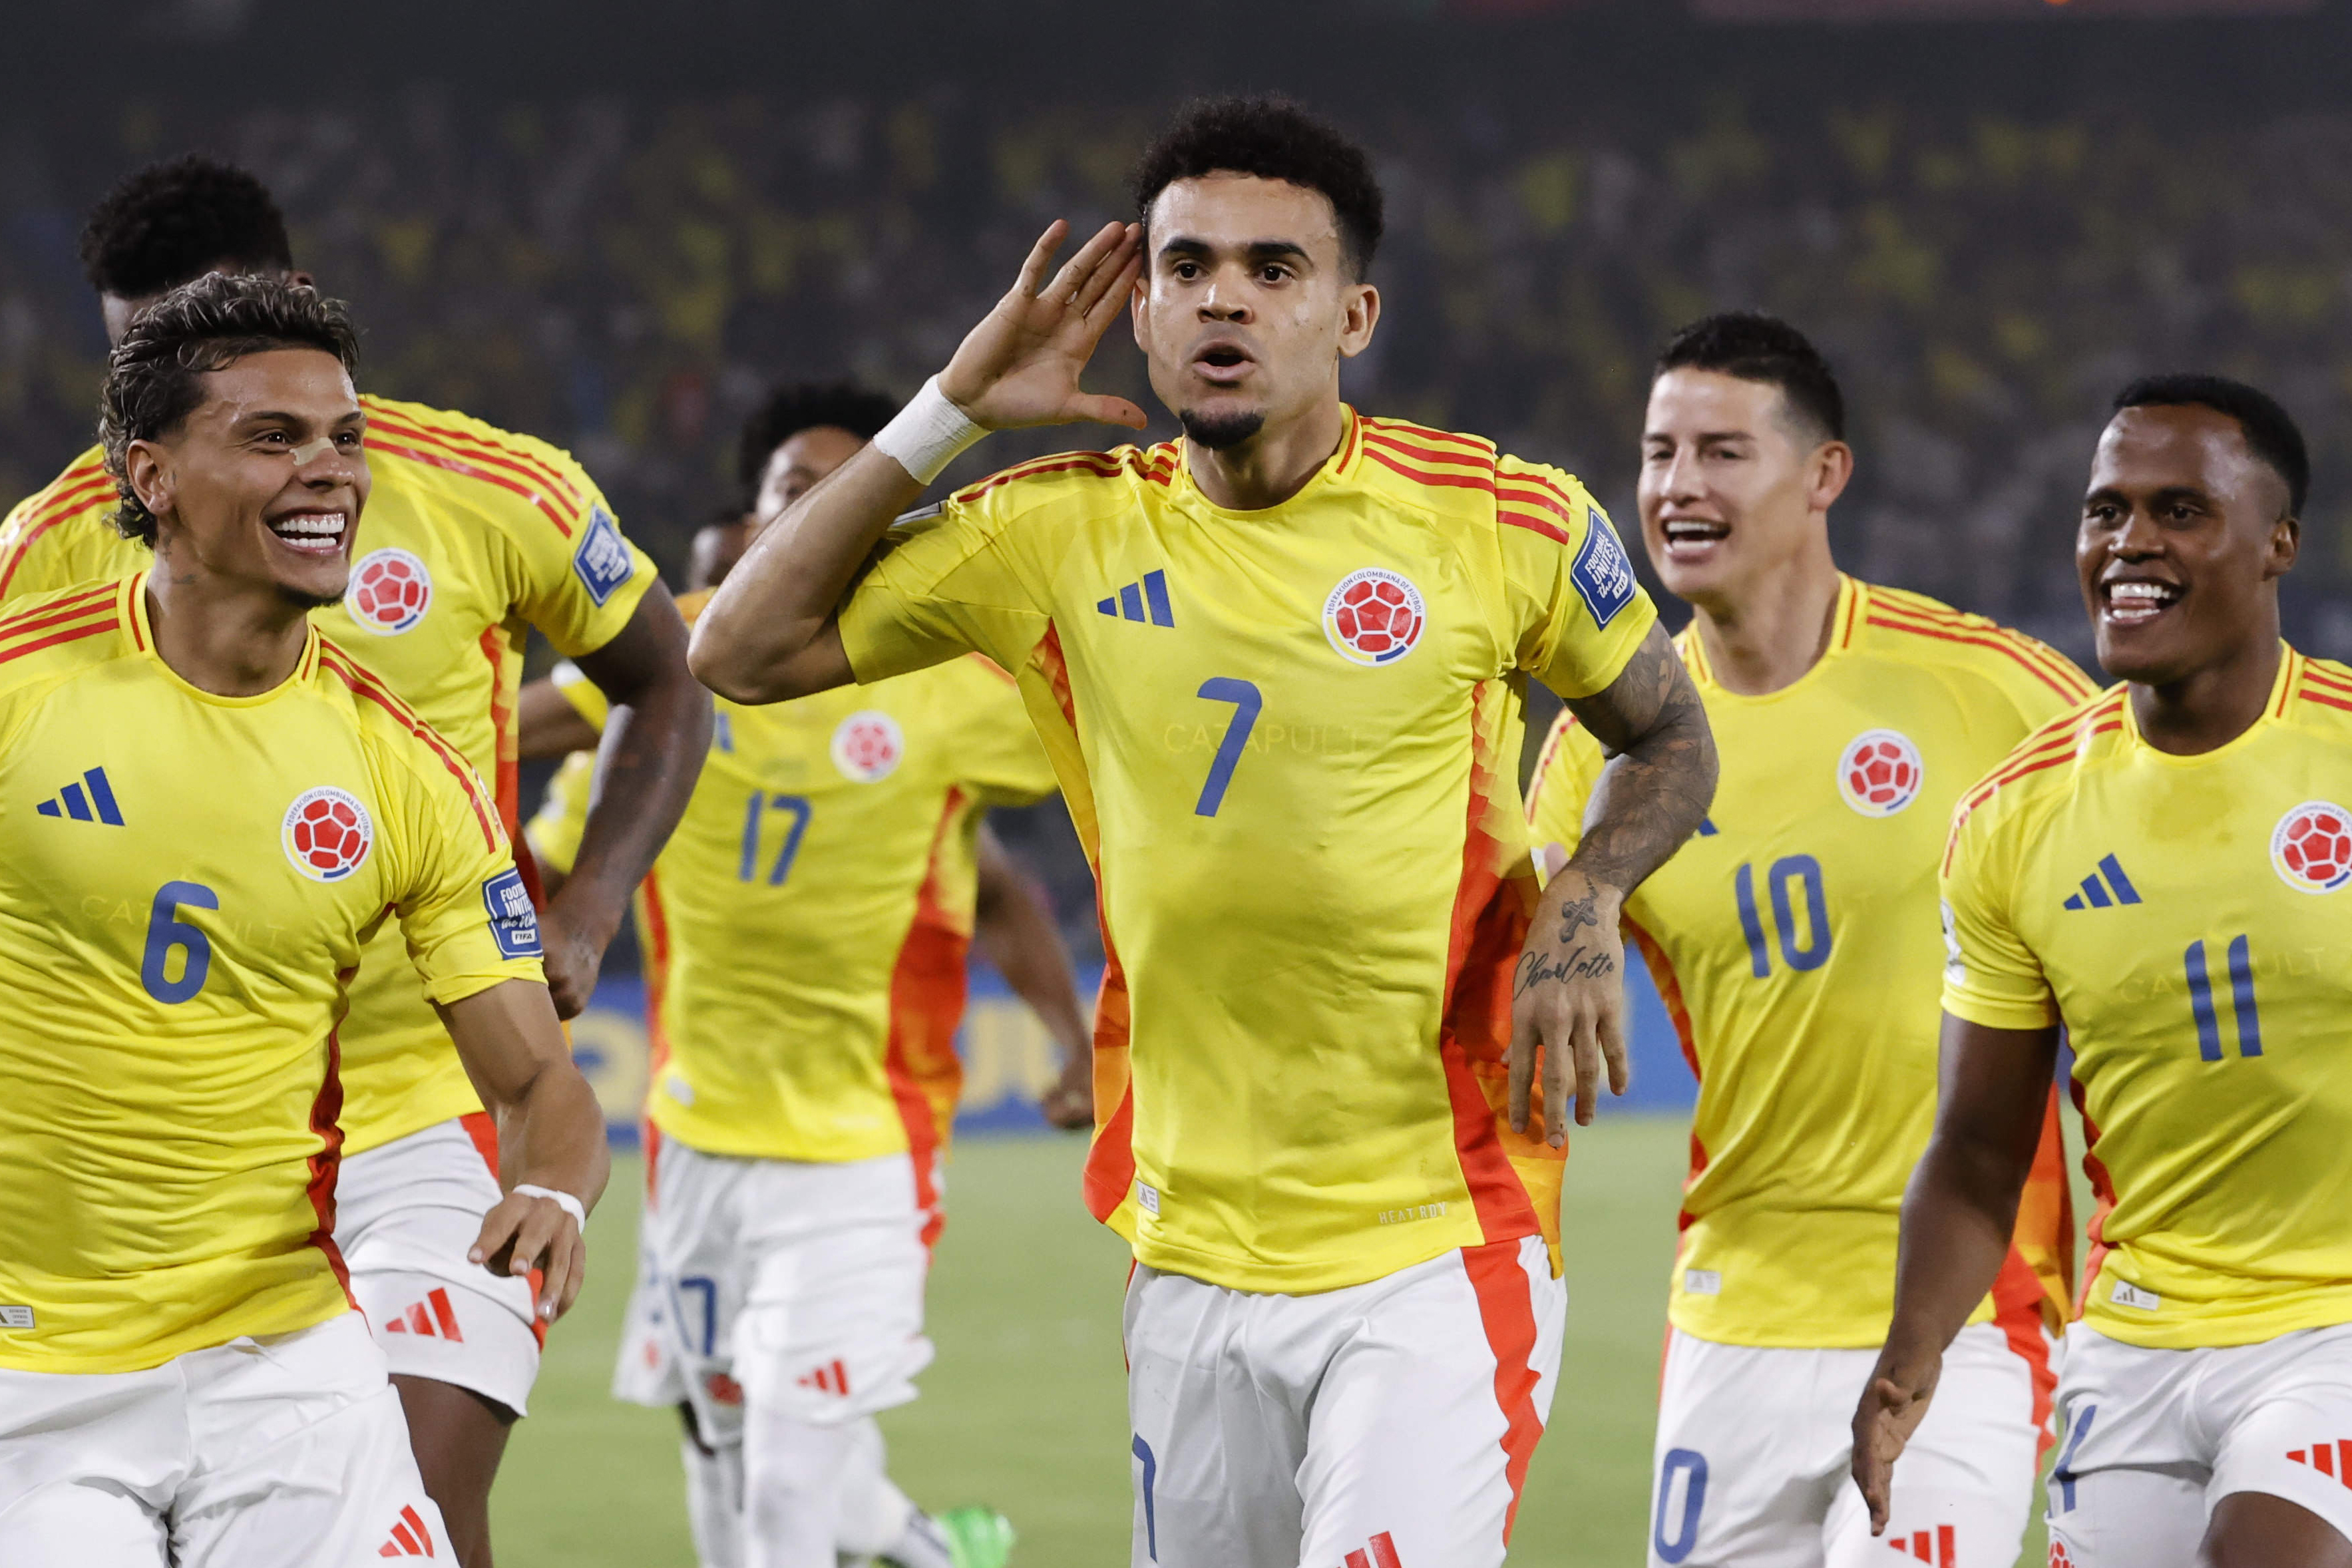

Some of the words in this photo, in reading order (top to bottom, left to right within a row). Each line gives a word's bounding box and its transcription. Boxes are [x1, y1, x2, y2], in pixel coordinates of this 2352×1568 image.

[1353, 571, 1400, 584] COLOMBIANA
[1400, 581, 1409, 590] DE
[1585, 530, 1606, 574] FOOTBALL
[1591, 537, 1614, 585] UNITES
[1597, 580, 1613, 599] the
[1195, 676, 1263, 818] 7
[313, 789, 354, 807] COLOMBIANA
[353, 804, 362, 813] DE
[739, 789, 811, 885] 17
[141, 881, 218, 1005] 6
[1735, 854, 1833, 978] 10
[1512, 945, 1614, 1001] Charlotte
[2184, 934, 2263, 1062] 11
[1132, 1432, 1157, 1564] 7
